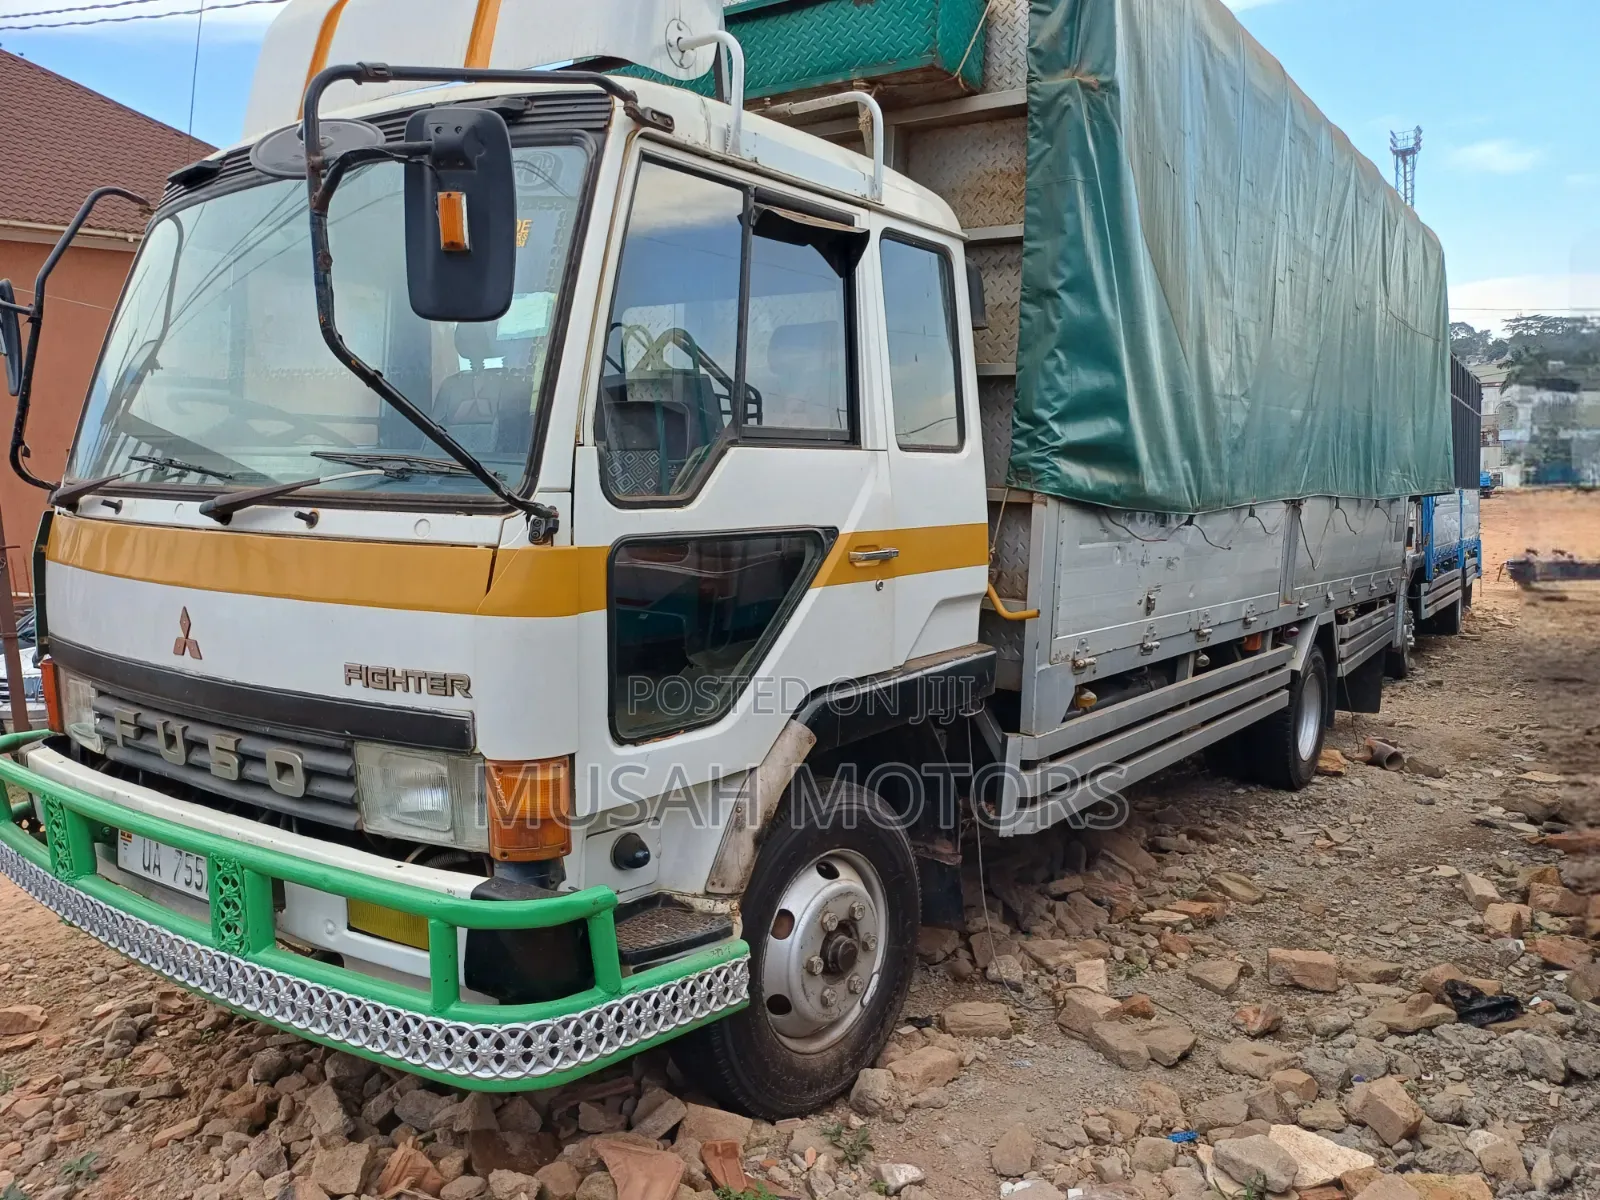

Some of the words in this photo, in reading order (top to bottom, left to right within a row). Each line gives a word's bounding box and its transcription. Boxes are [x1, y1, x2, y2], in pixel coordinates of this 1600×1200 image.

[344, 662, 473, 698] FIGHTER
[114, 707, 306, 797] FUSO
[142, 838, 162, 877] UA
[173, 849, 209, 892] 755
